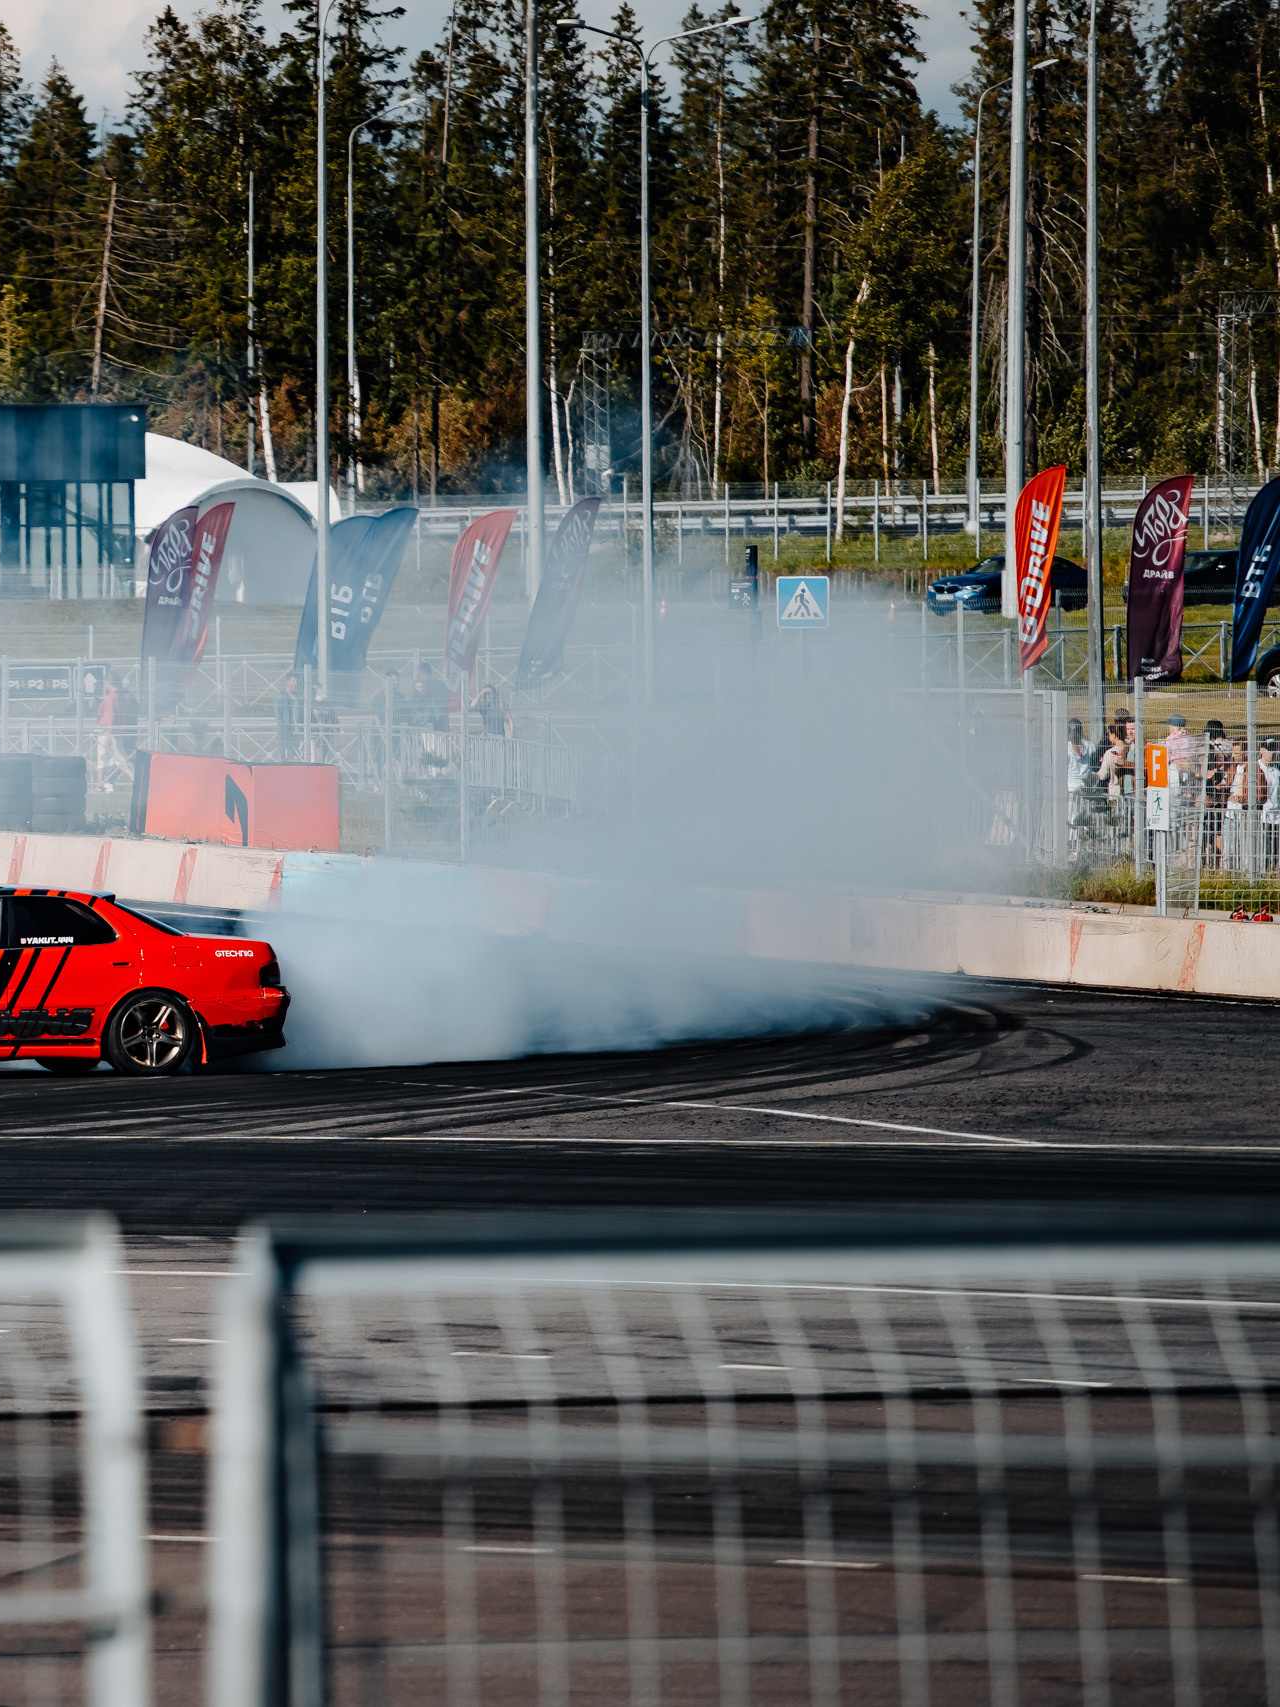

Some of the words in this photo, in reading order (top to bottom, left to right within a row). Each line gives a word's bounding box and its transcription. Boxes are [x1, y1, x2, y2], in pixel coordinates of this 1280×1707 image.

[191, 531, 217, 640] RIVE
[1143, 569, 1175, 579] ДРАЙВ
[1152, 750, 1161, 781] F
